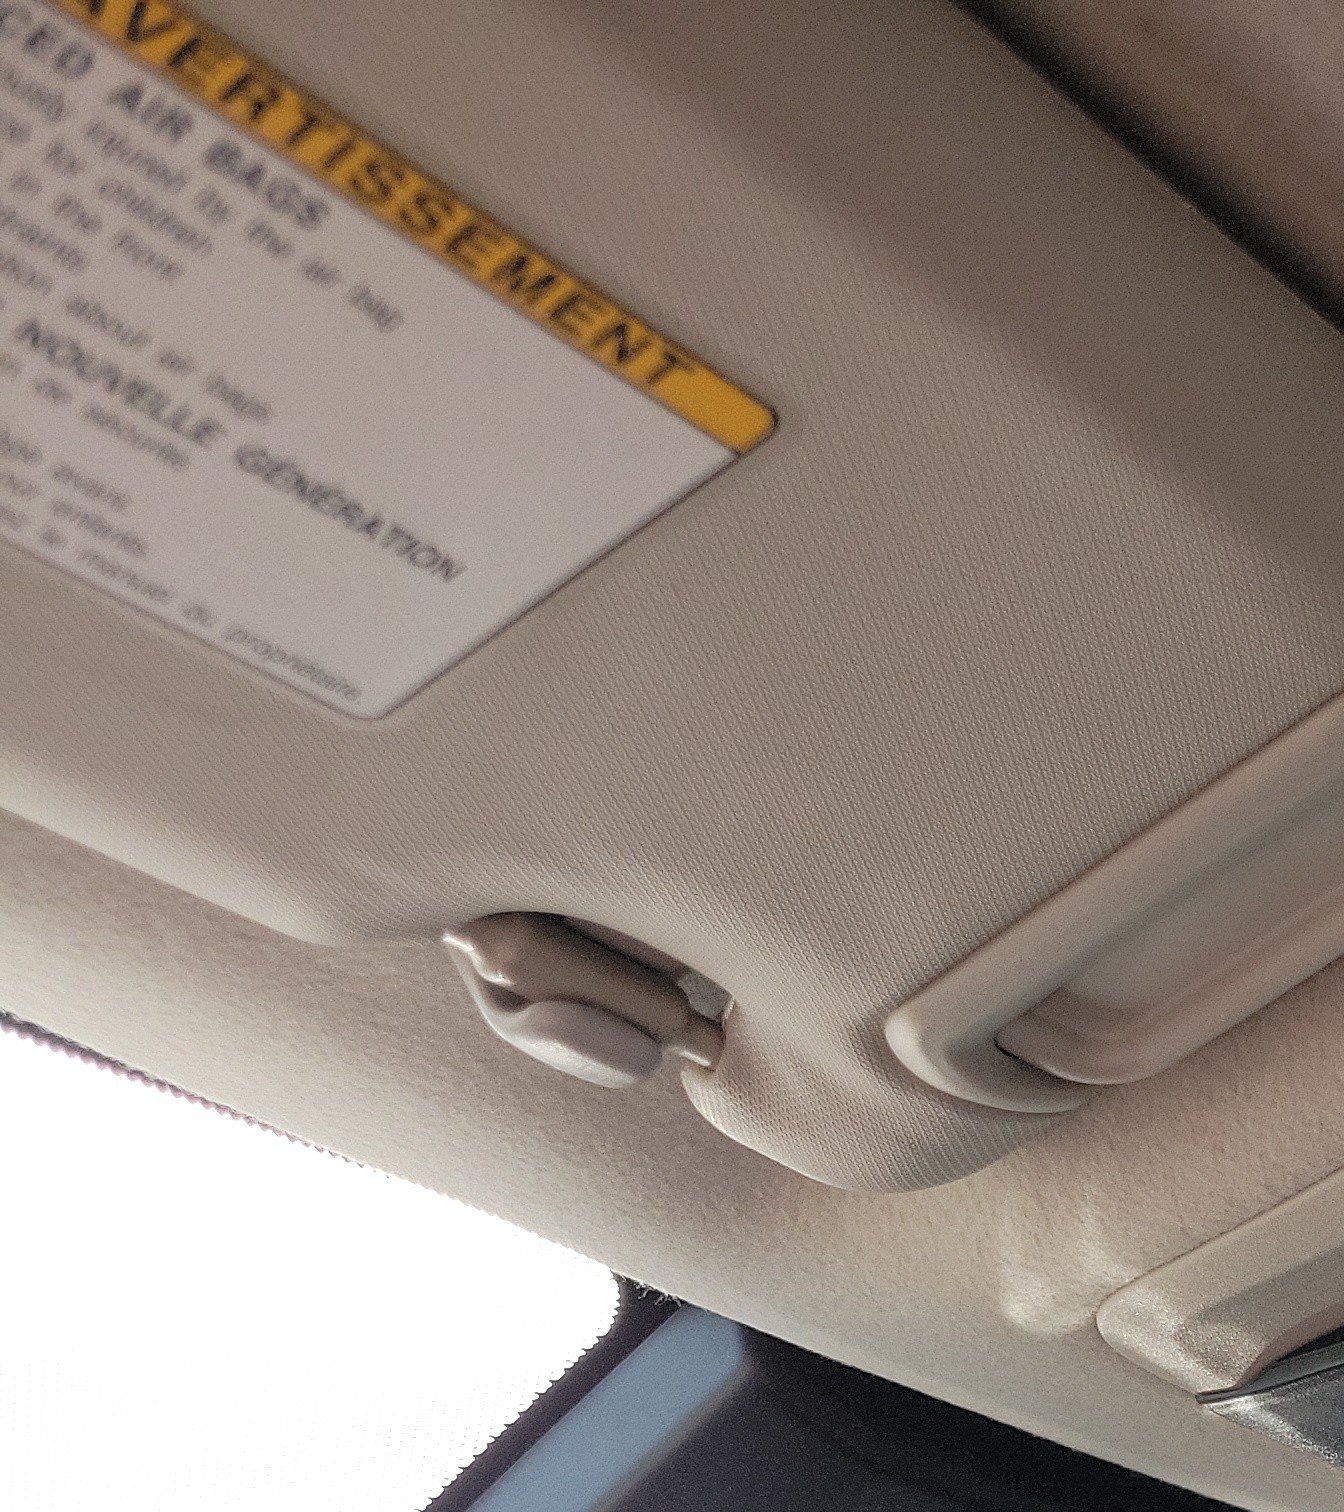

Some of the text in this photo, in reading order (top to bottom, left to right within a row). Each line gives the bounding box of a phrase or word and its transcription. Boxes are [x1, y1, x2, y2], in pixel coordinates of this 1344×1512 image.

[107, 83, 194, 144] AIR
[203, 138, 330, 231] BAGS
[13, 317, 227, 451] NOUVELLE
